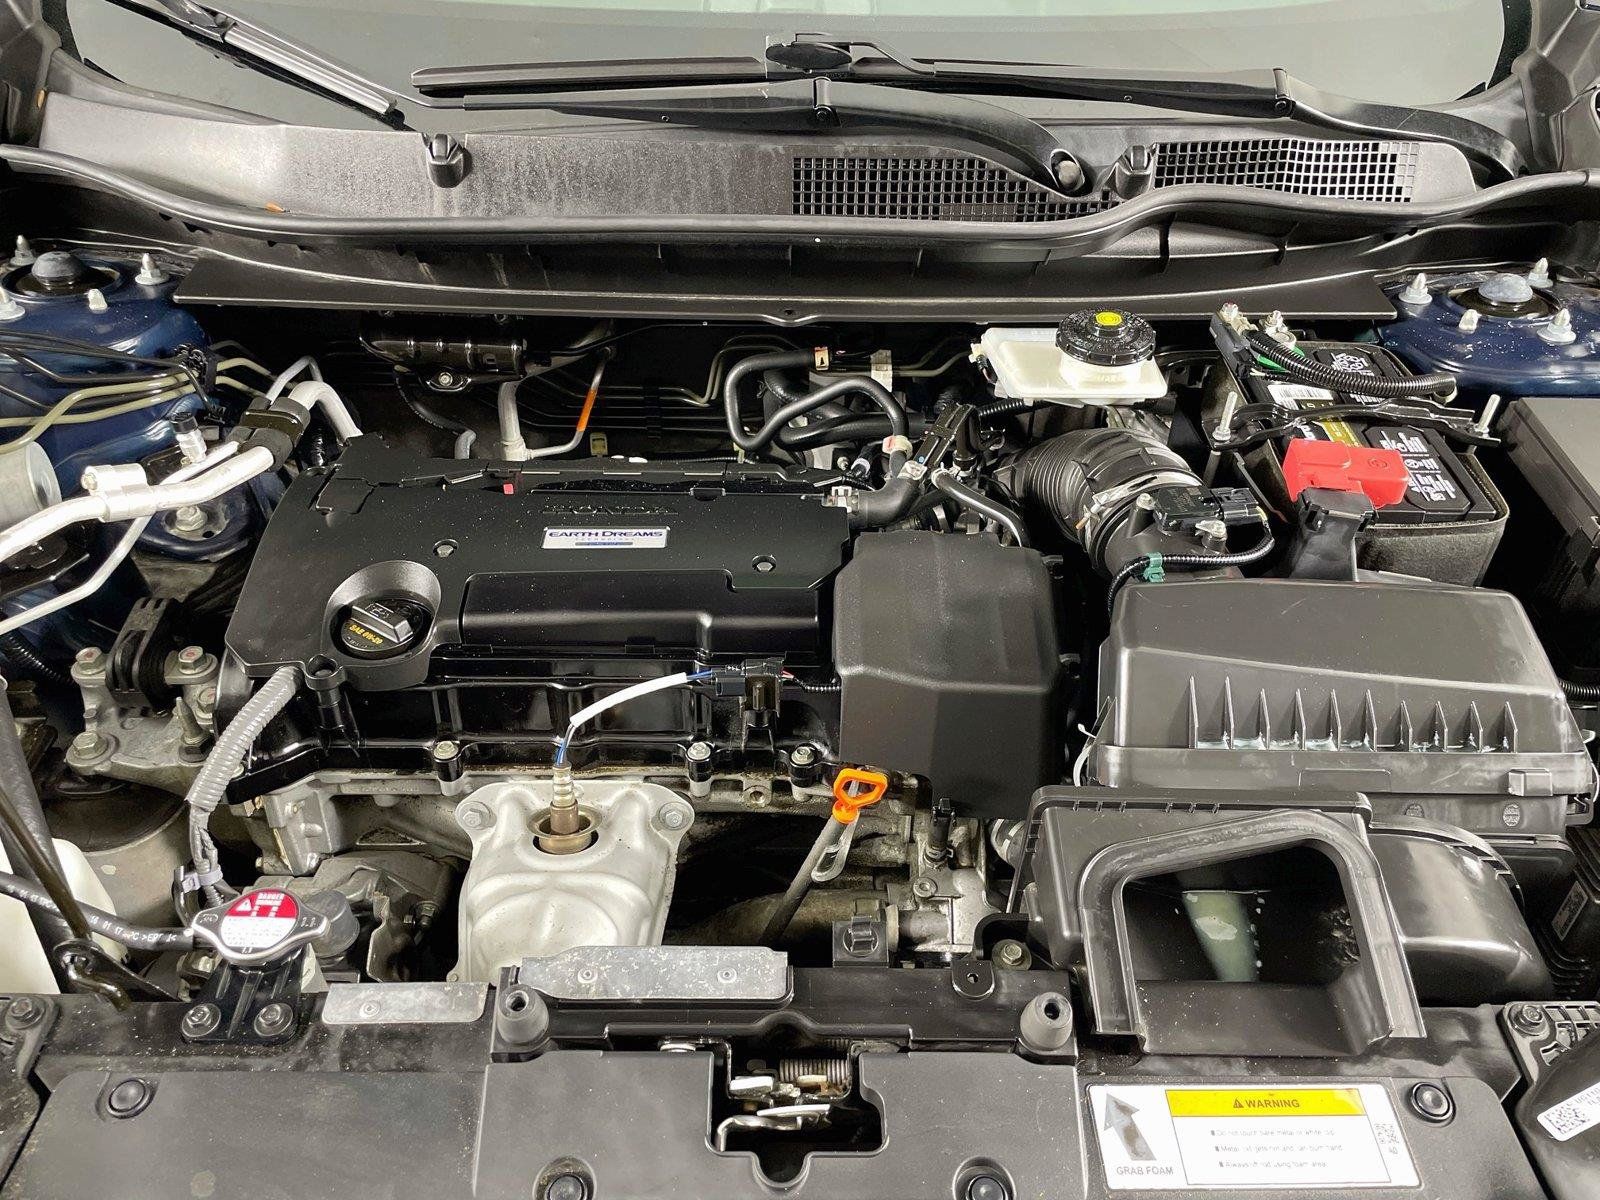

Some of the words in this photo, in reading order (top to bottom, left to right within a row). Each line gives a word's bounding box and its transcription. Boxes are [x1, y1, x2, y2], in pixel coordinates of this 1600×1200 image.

[1245, 1099, 1300, 1108] WARNING
[1116, 1166, 1143, 1175] GRAB
[1146, 1166, 1174, 1175] FOAM
